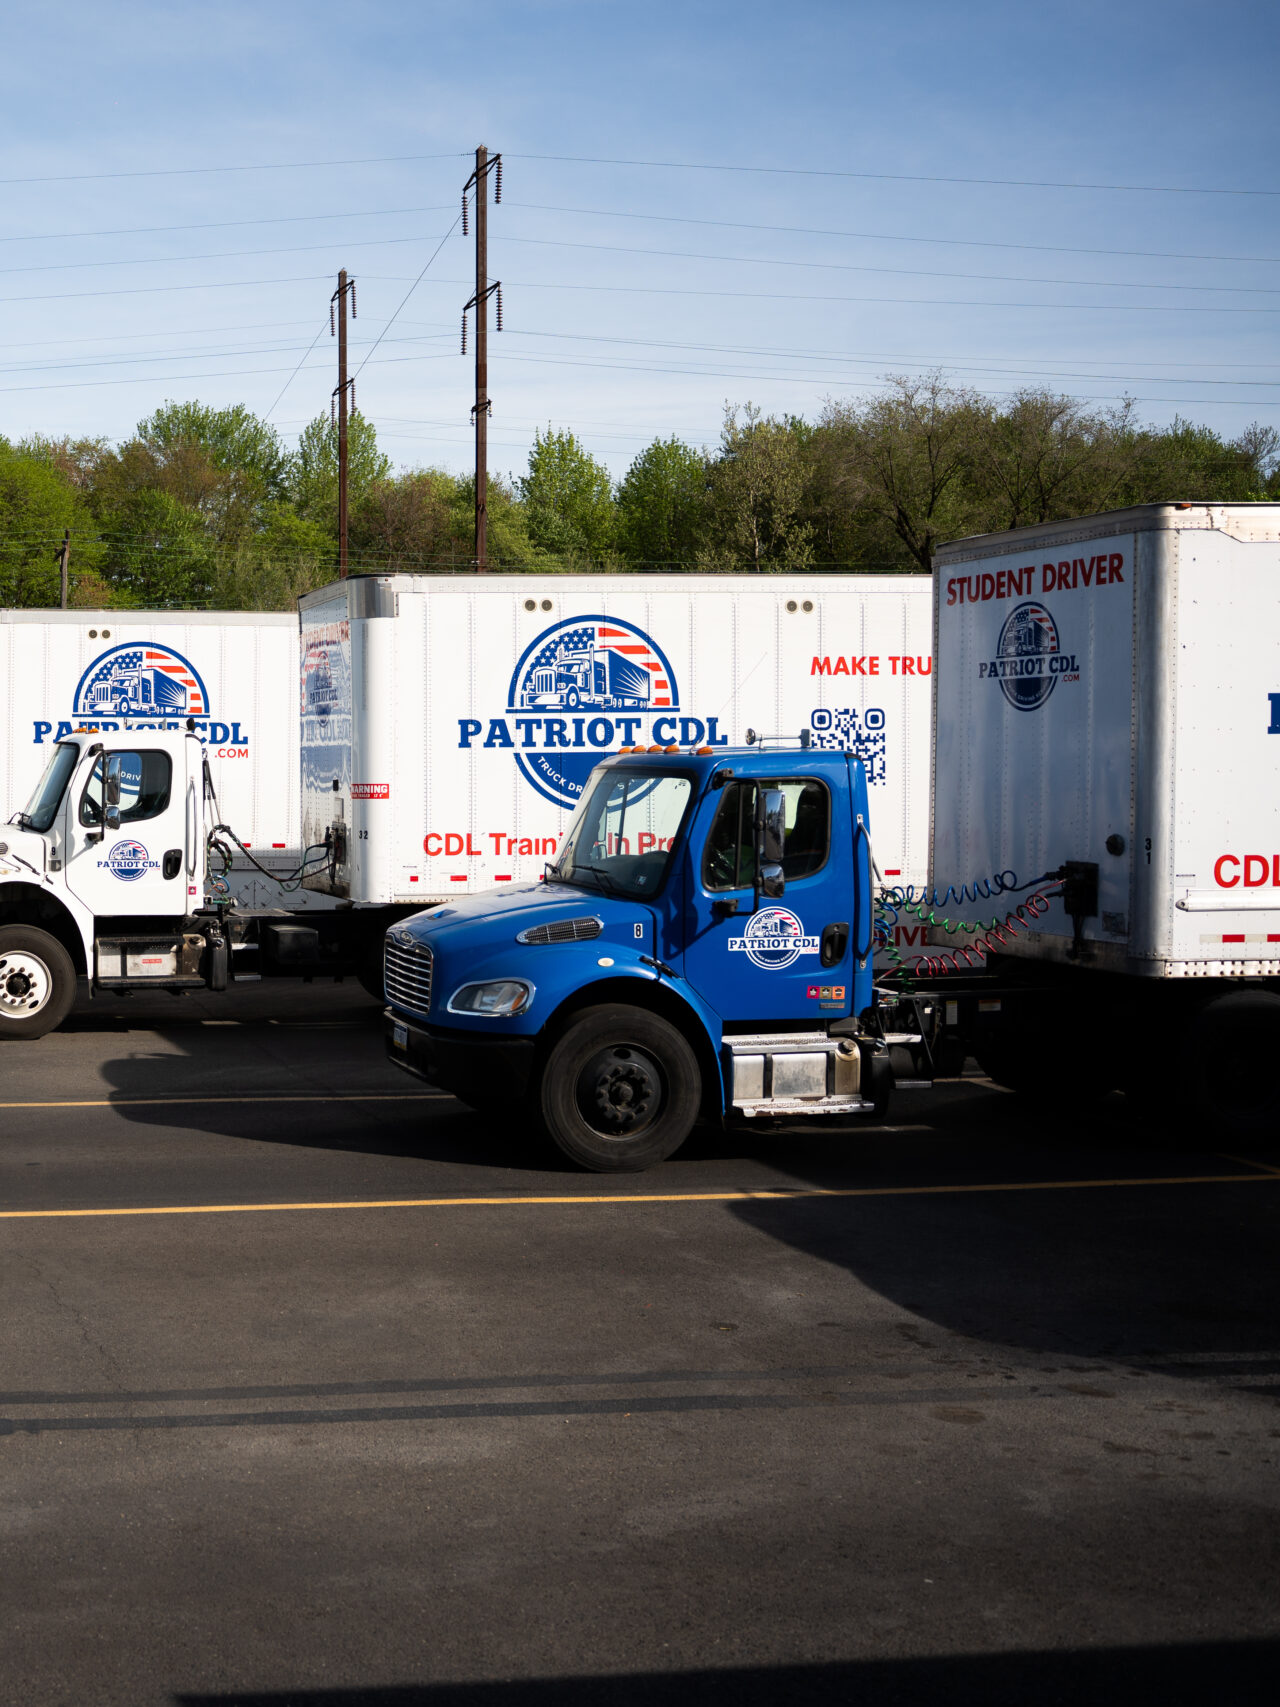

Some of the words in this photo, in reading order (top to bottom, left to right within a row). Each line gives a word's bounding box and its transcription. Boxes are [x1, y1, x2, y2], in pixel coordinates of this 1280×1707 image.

[946, 566, 1036, 606] STUDENT
[1042, 552, 1125, 593] DRIVER
[810, 656, 880, 676] MAKE
[978, 657, 1046, 679] PATRIOT
[1049, 655, 1080, 674] CDL
[1061, 674, 1080, 682] .COM
[458, 717, 642, 749] PATRIOT
[652, 716, 728, 747] CDL
[214, 748, 249, 759] .COM
[120, 770, 141, 781] DRIV
[537, 755, 567, 787] TRUCK
[358, 830, 368, 840] 32
[51, 846, 56, 856] 9
[423, 832, 482, 857] CDL
[142, 860, 161, 868] CDL
[635, 924, 642, 938] 8
[729, 938, 790, 950] PATRIOT
[793, 938, 819, 948] CDL
